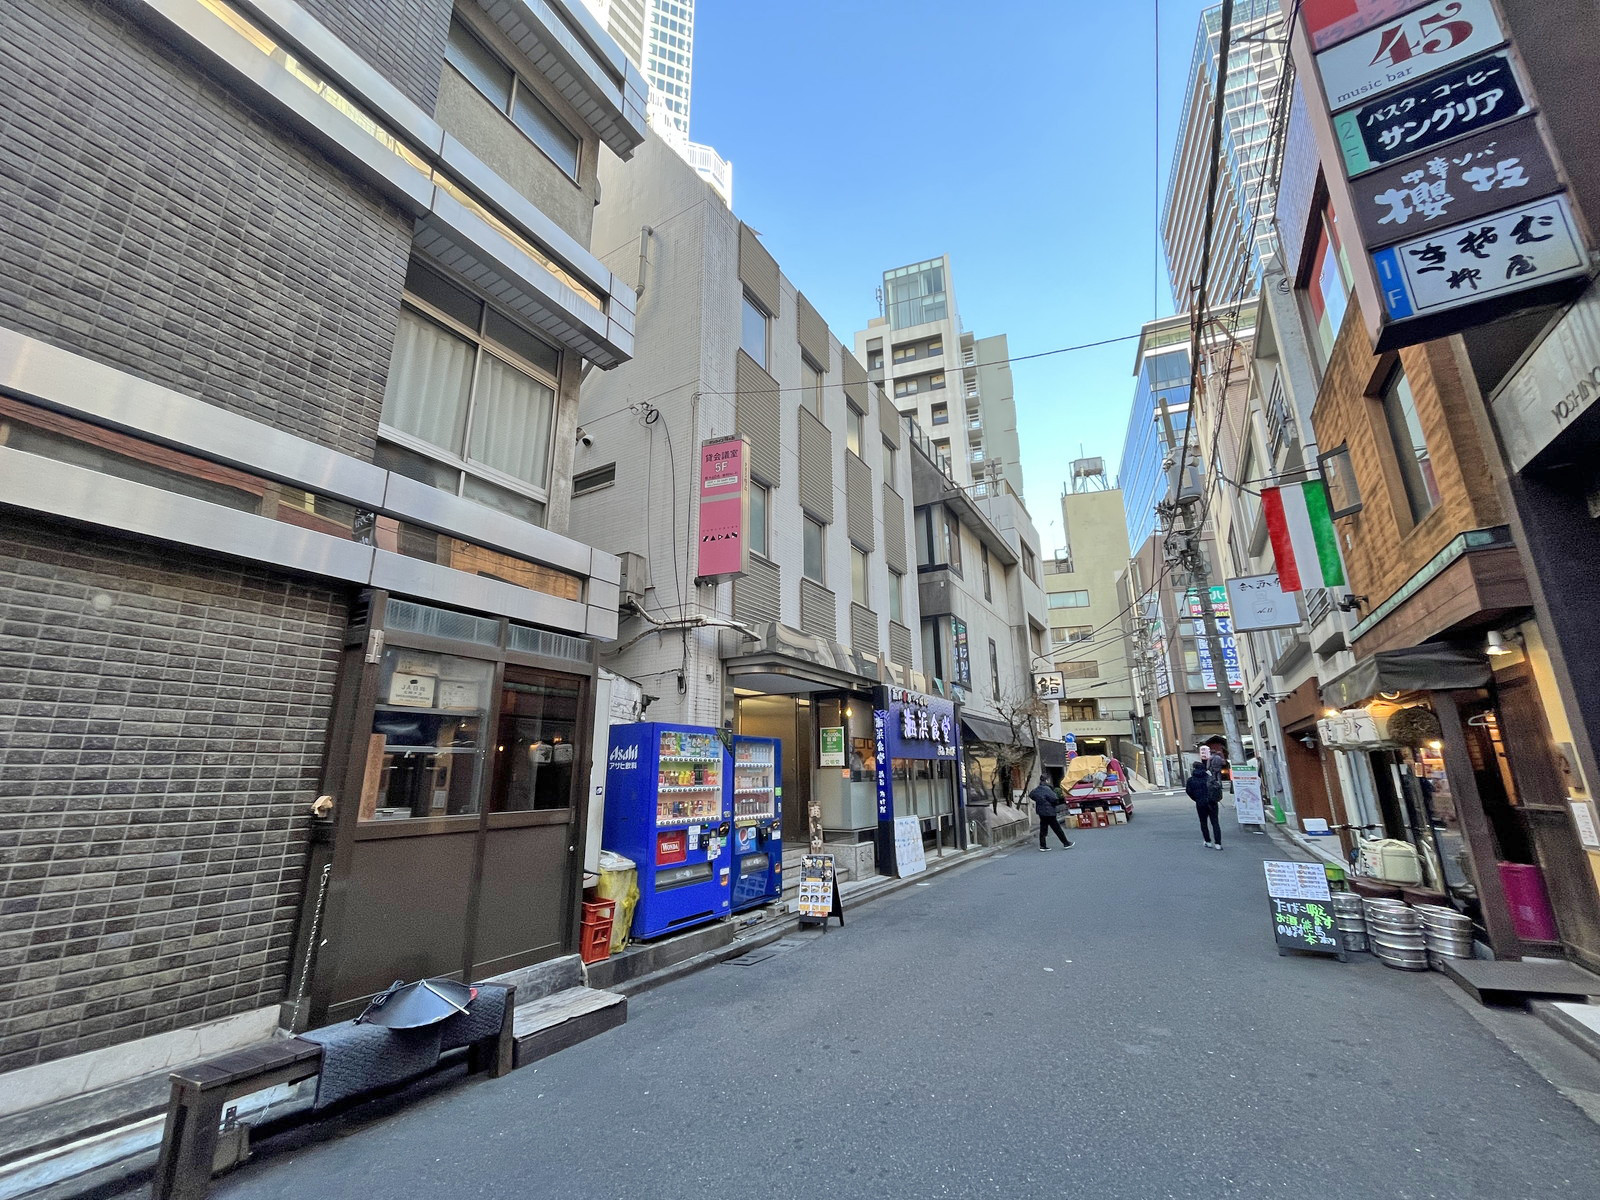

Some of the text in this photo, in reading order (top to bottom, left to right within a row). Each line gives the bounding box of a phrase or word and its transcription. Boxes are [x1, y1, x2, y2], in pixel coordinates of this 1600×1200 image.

[1368, 2, 1473, 68] 45
[1337, 65, 1413, 103] music bar
[1378, 88, 1503, 150] サングリア
[1446, 254, 1538, 290] 柳屋
[705, 449, 738, 462] 貸会議室
[715, 461, 728, 473] 5F
[1038, 676, 1060, 696] 鮨
[609, 744, 639, 761] Asahi
[609, 762, 638, 770] アサヒ飲料
[661, 841, 680, 852] WONDA
